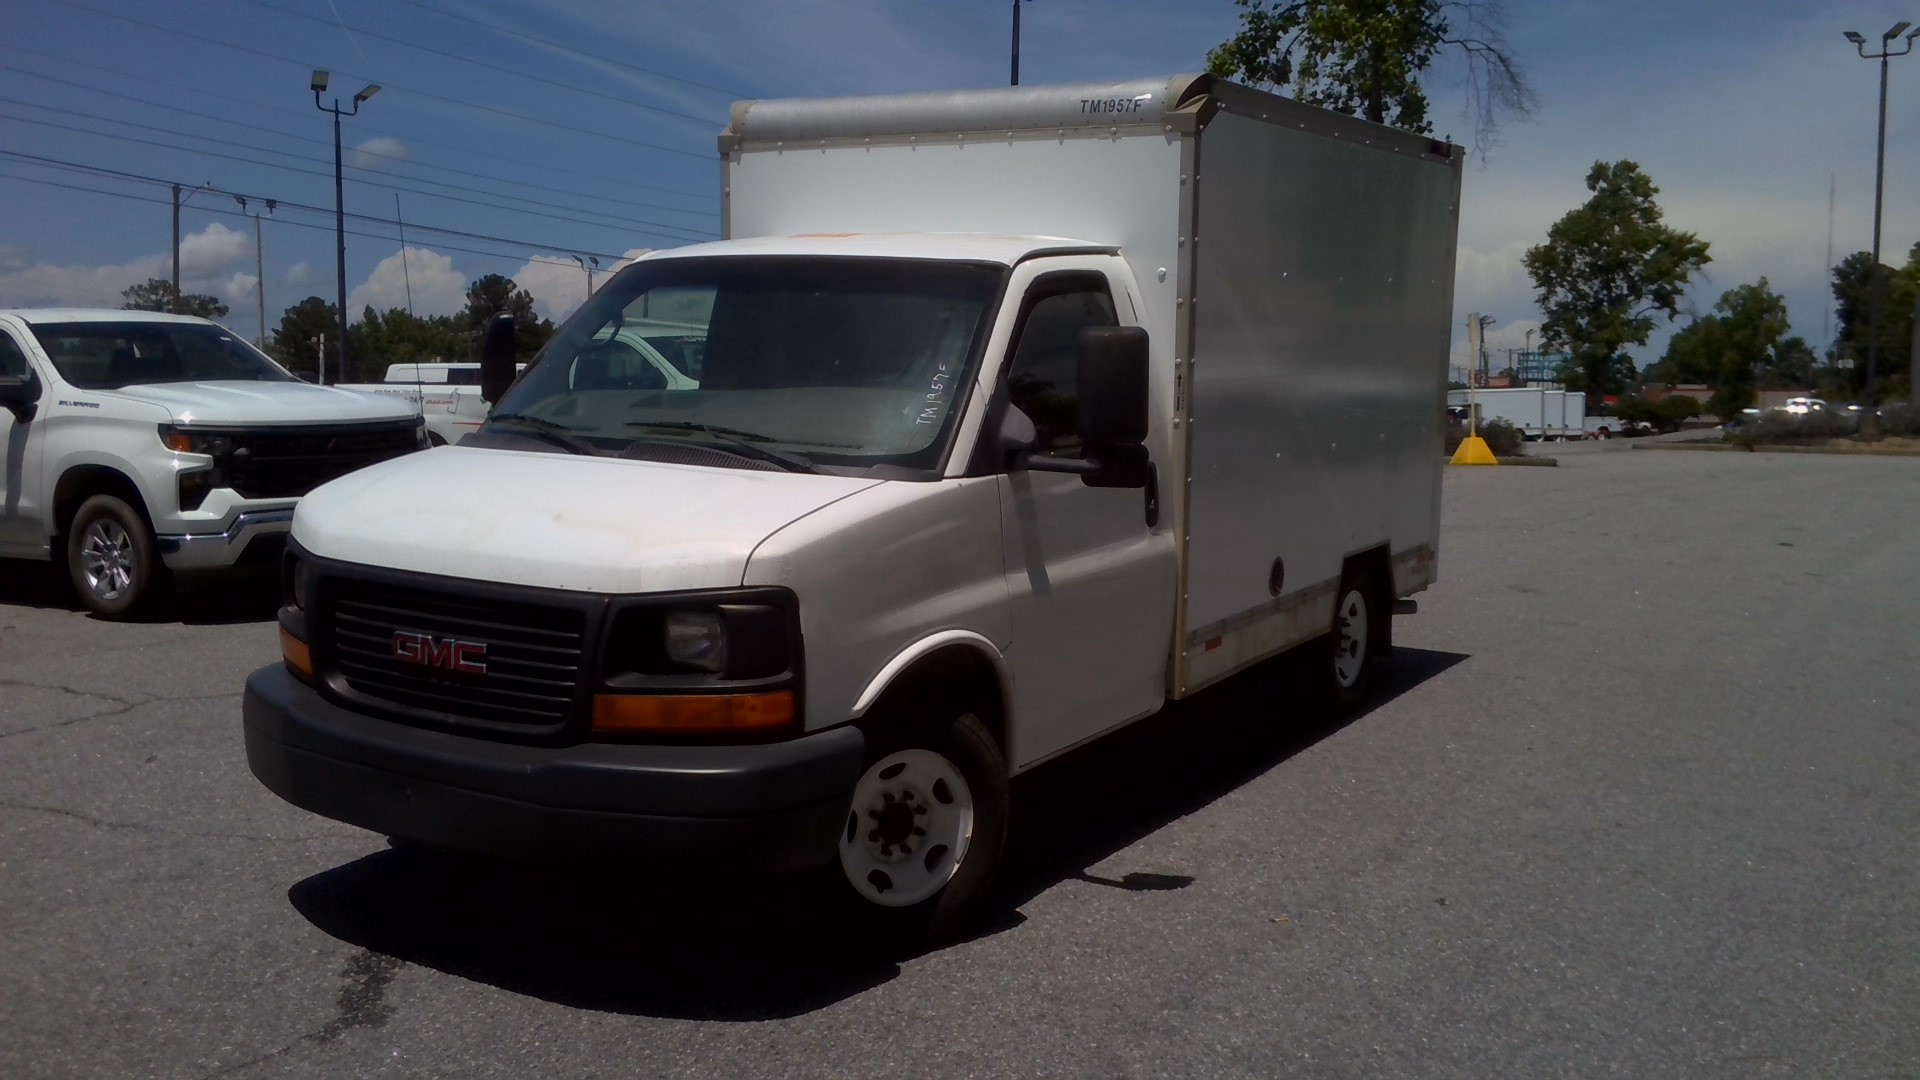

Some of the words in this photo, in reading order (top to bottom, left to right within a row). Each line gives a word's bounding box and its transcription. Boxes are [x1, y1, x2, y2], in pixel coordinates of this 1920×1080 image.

[1080, 99, 1143, 114] TM1957F
[915, 362, 950, 425] TM1957F
[392, 630, 487, 673] GMC
